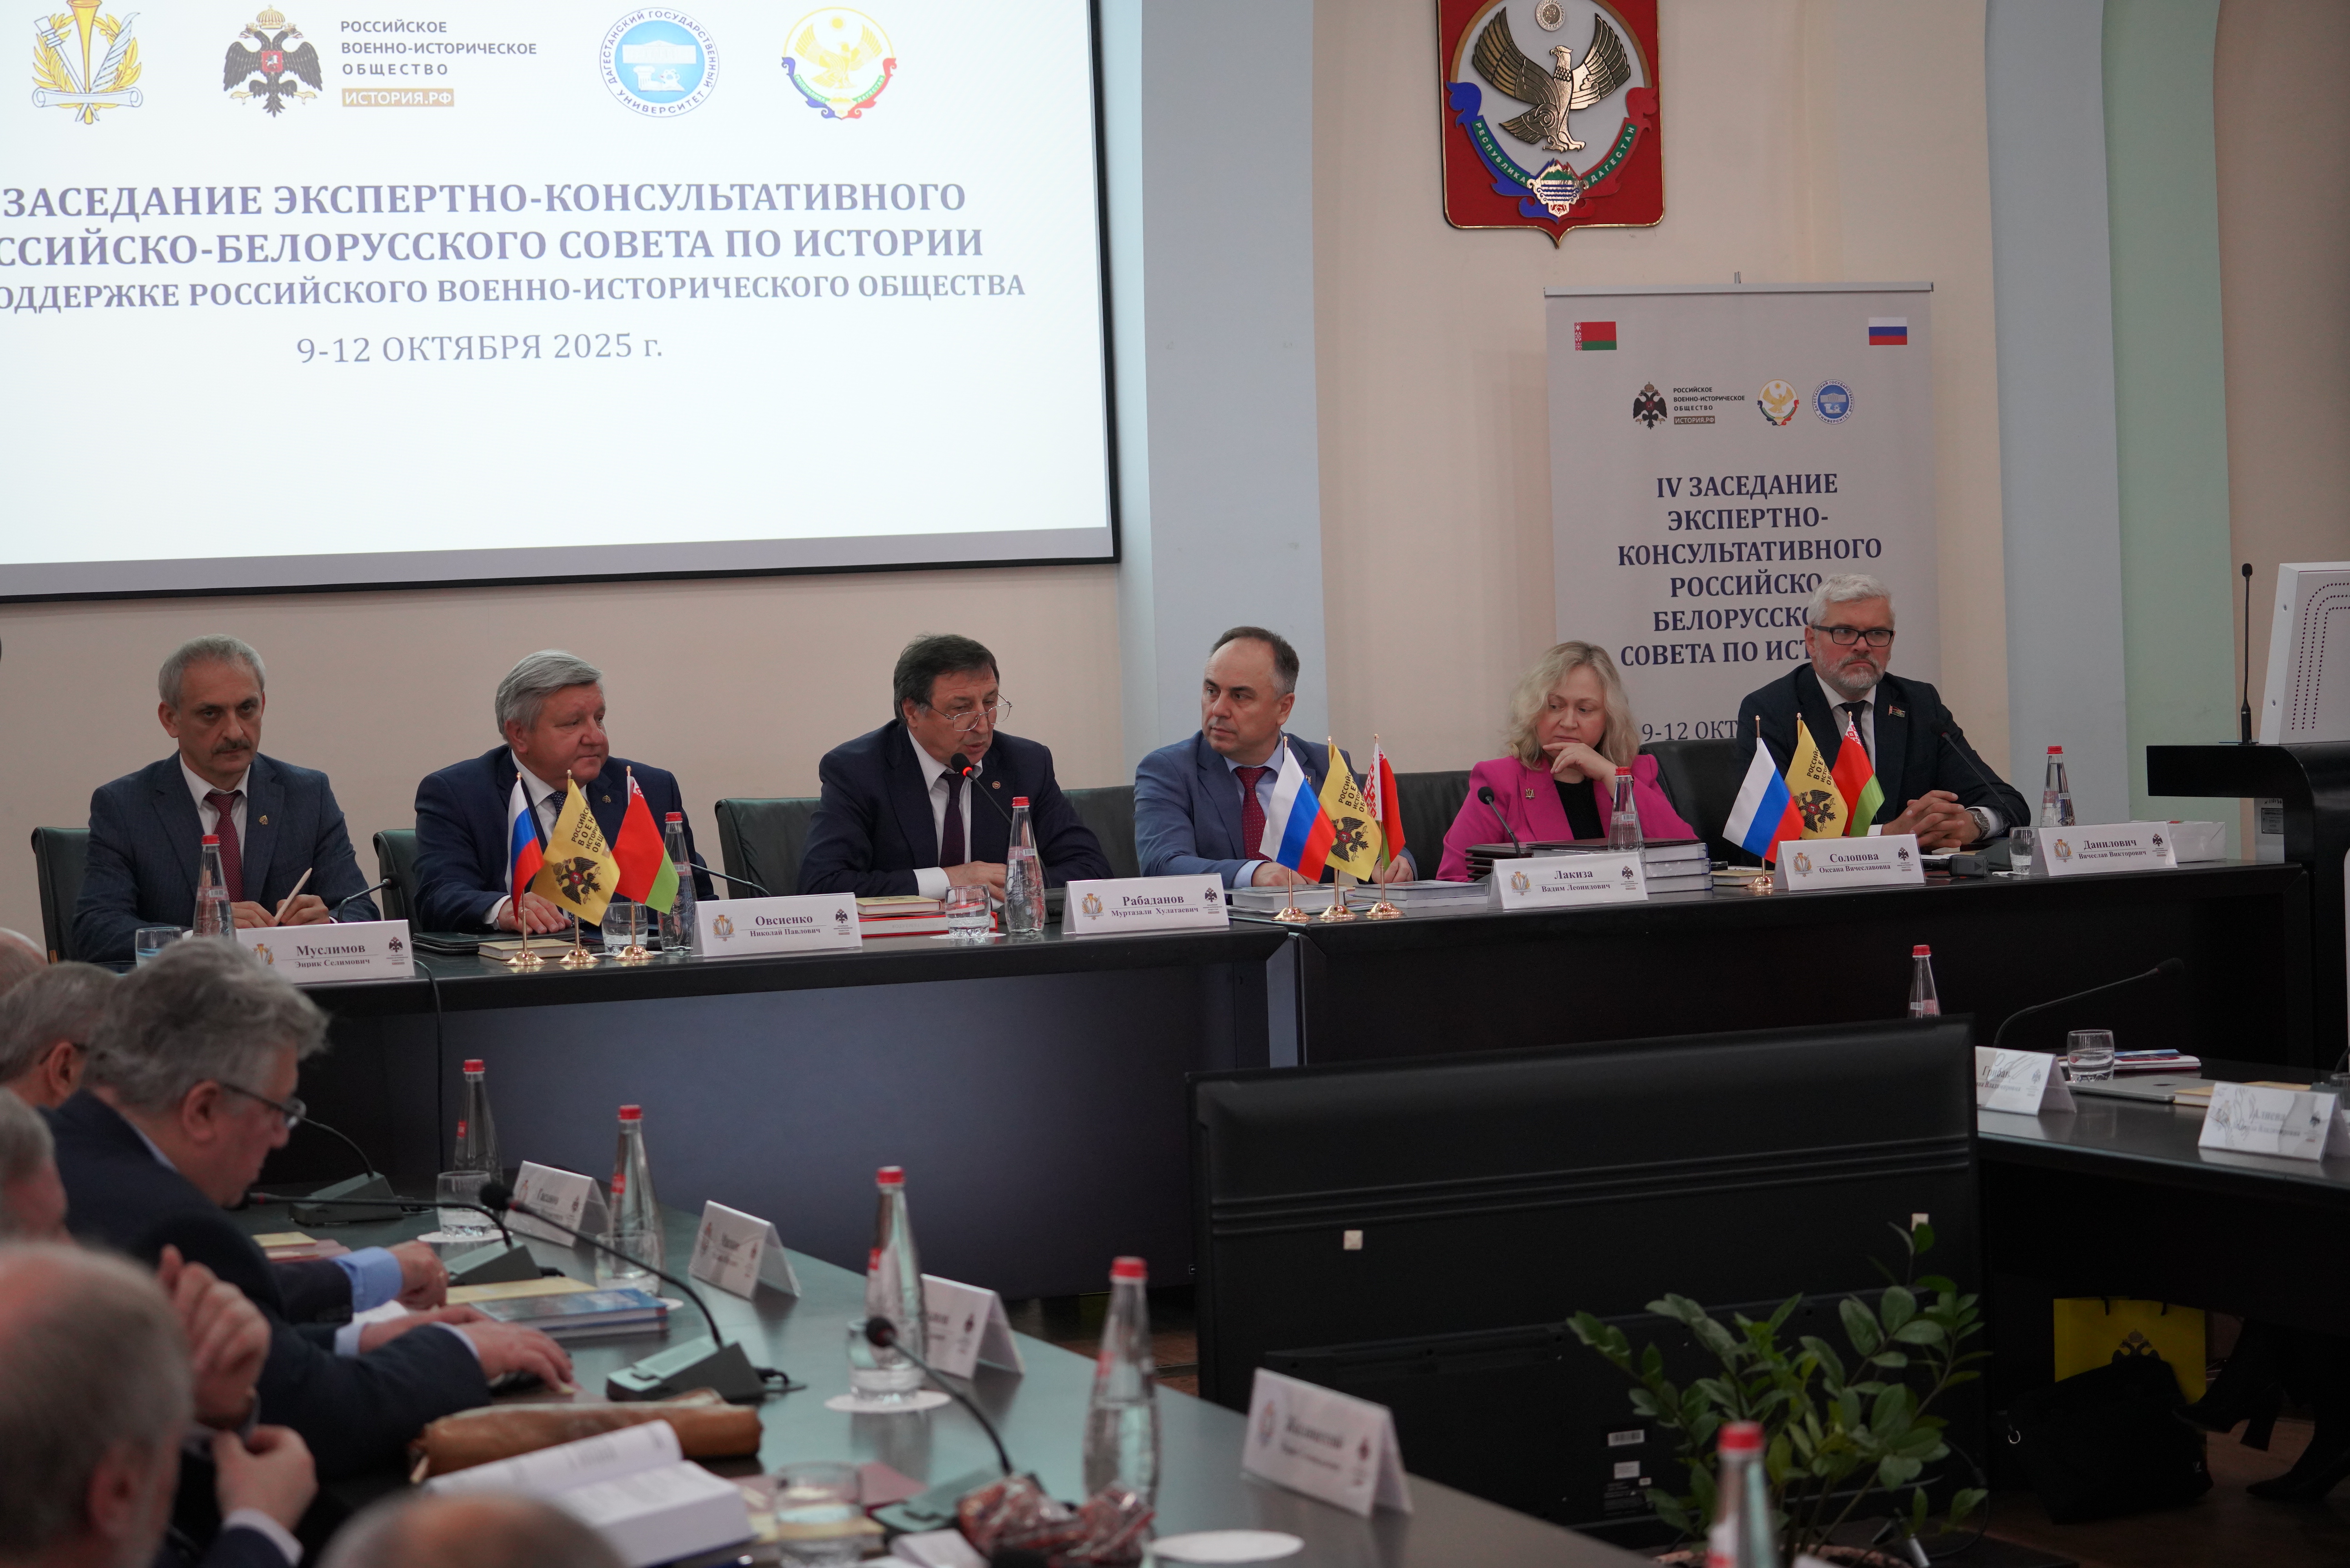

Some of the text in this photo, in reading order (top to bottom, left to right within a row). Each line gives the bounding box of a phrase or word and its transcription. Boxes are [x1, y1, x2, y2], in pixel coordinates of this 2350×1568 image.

[341, 19, 447, 33] РОССИЙСКОЕ
[341, 42, 537, 55] ВОЕННО-ИСТОРИЧЕСКОЕ
[342, 63, 447, 76] ОБЩЕСТВО
[603, 10, 717, 115] ДАГЕСТАНСКИЙ ГОСУДАРСТВЕННЫЙ УНИВЕРСИТЕТ
[345, 90, 452, 106] ИСТОРИЯ.РФ
[1476, 123, 1635, 183] РЕСПУБЛИКА ДАГЕСТАН
[3, 183, 965, 223] ЗАСЕДАНИЕ ЭКСПЕРТНО-КОНСУЛЬТАТИВНОГО
[559, 230, 715, 259] СОВЕТА
[725, 230, 781, 257] ПО
[793, 229, 983, 257] ИСТОРИИ
[189, 276, 427, 306] РОССИЙСКОГО
[437, 276, 849, 302] ВОЕННО-ИСТОРИЧЕСКОГО
[858, 274, 1026, 301] ОБЩЕСТВА
[297, 332, 662, 363] 9-12 ОКТЯБРЯ 2025 г.
[1818, 413, 1849, 423] УНИВЕРСИТЕТ
[1657, 473, 1838, 500] IV ЗАСЕДАНИЕ
[1668, 507, 1828, 531] ЭКСПЕРТНО-
[1617, 538, 1882, 566] КОНСУЛЬТАТИВНОГО
[1653, 606, 1808, 632] БЕЛОРУССК
[1621, 643, 1716, 666] СОВЕТА
[1722, 641, 1758, 662] ПО
[1642, 720, 1738, 741] 9-12 ОКТ
[1807, 745, 1818, 777] РОССИЙС
[1338, 770, 1351, 804] РОССИЙС
[2083, 839, 2137, 851] Данилович
[1830, 853, 1879, 863] Солопова
[1554, 870, 1593, 879] Лакиза
[1123, 895, 1185, 906] Рабаданов
[755, 915, 813, 926] Овсиенко
[1111, 910, 1152, 918] Муртазали
[1156, 907, 1199, 915] Хулатаевич
[750, 927, 821, 937] Николай Павлович
[296, 945, 366, 958] Муслимов
[295, 958, 371, 969] Энрик Селимович
